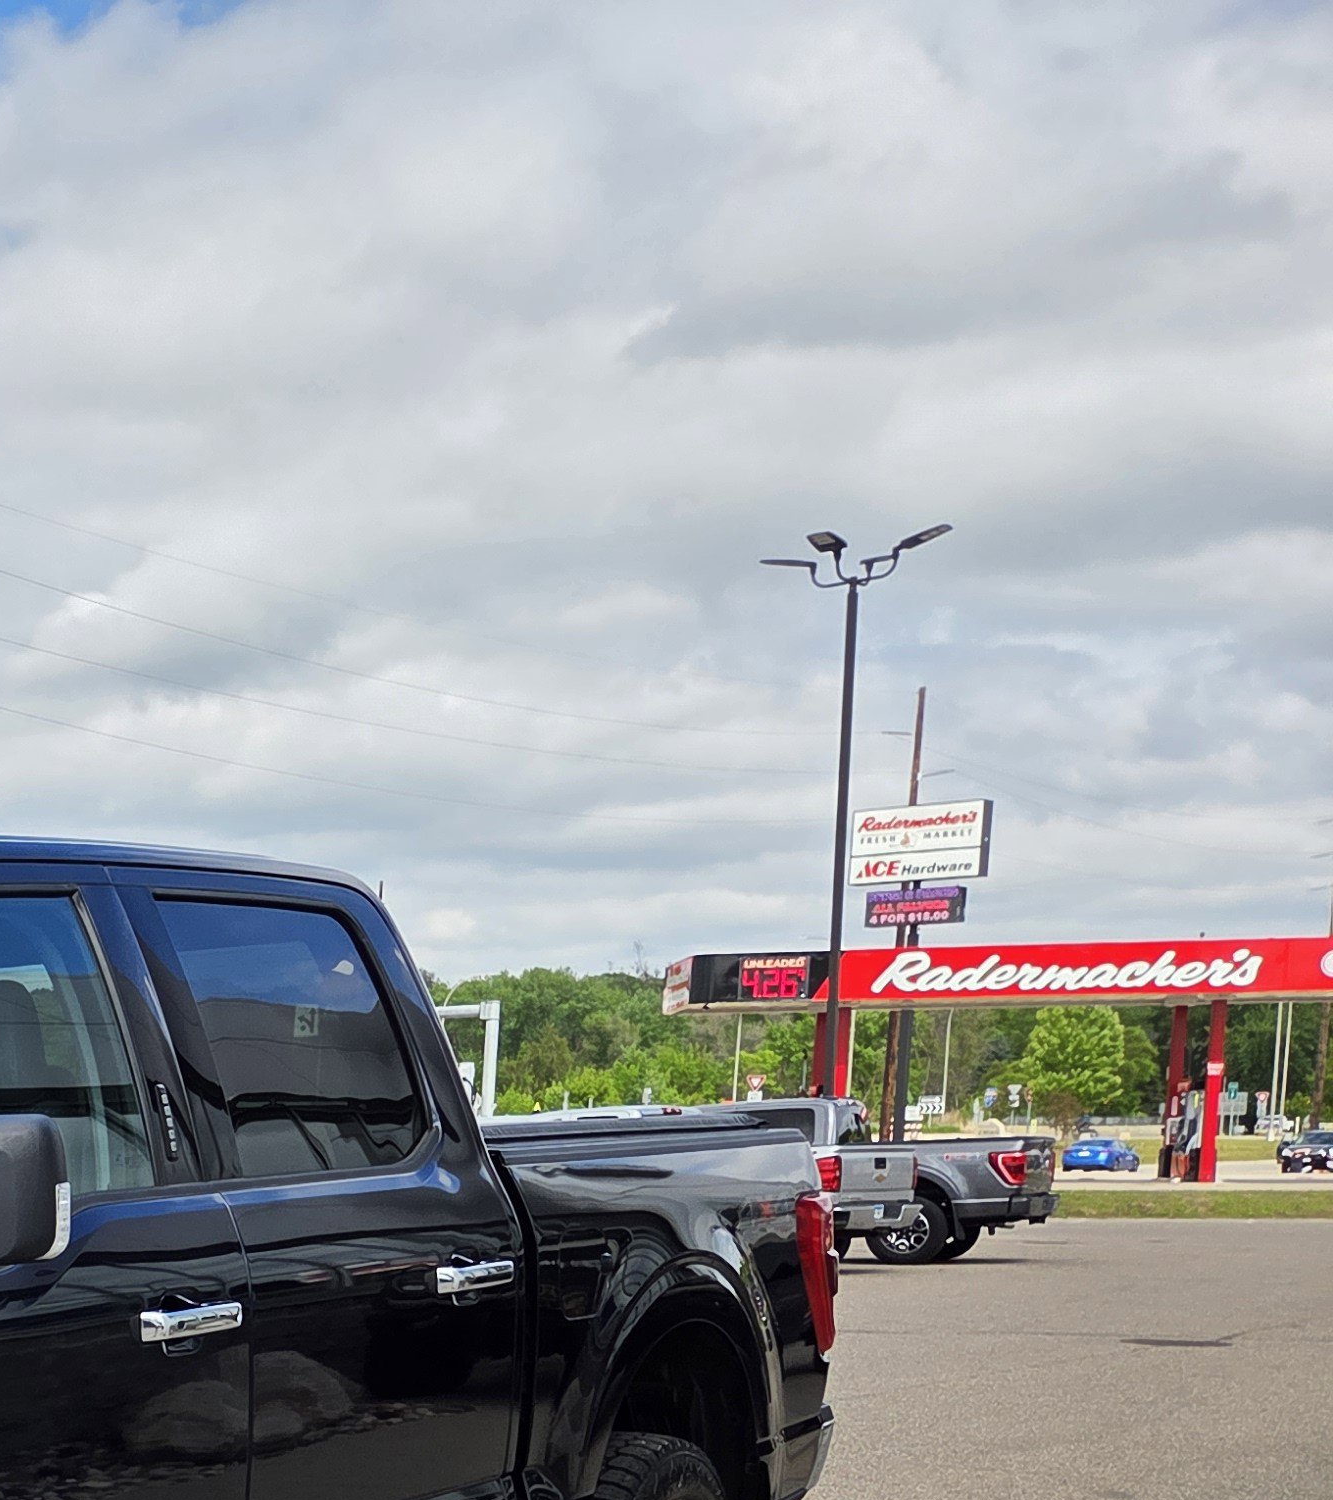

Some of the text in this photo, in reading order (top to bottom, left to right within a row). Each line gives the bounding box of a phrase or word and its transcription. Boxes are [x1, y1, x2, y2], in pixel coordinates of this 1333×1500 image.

[857, 811, 978, 833] Radermacher's
[860, 828, 973, 844] FRESH MARKET
[856, 859, 973, 879] ACE Hardware
[880, 913, 906, 923] FOR
[744, 957, 806, 969] UNLEADED
[871, 949, 1264, 993] Radermacher's
